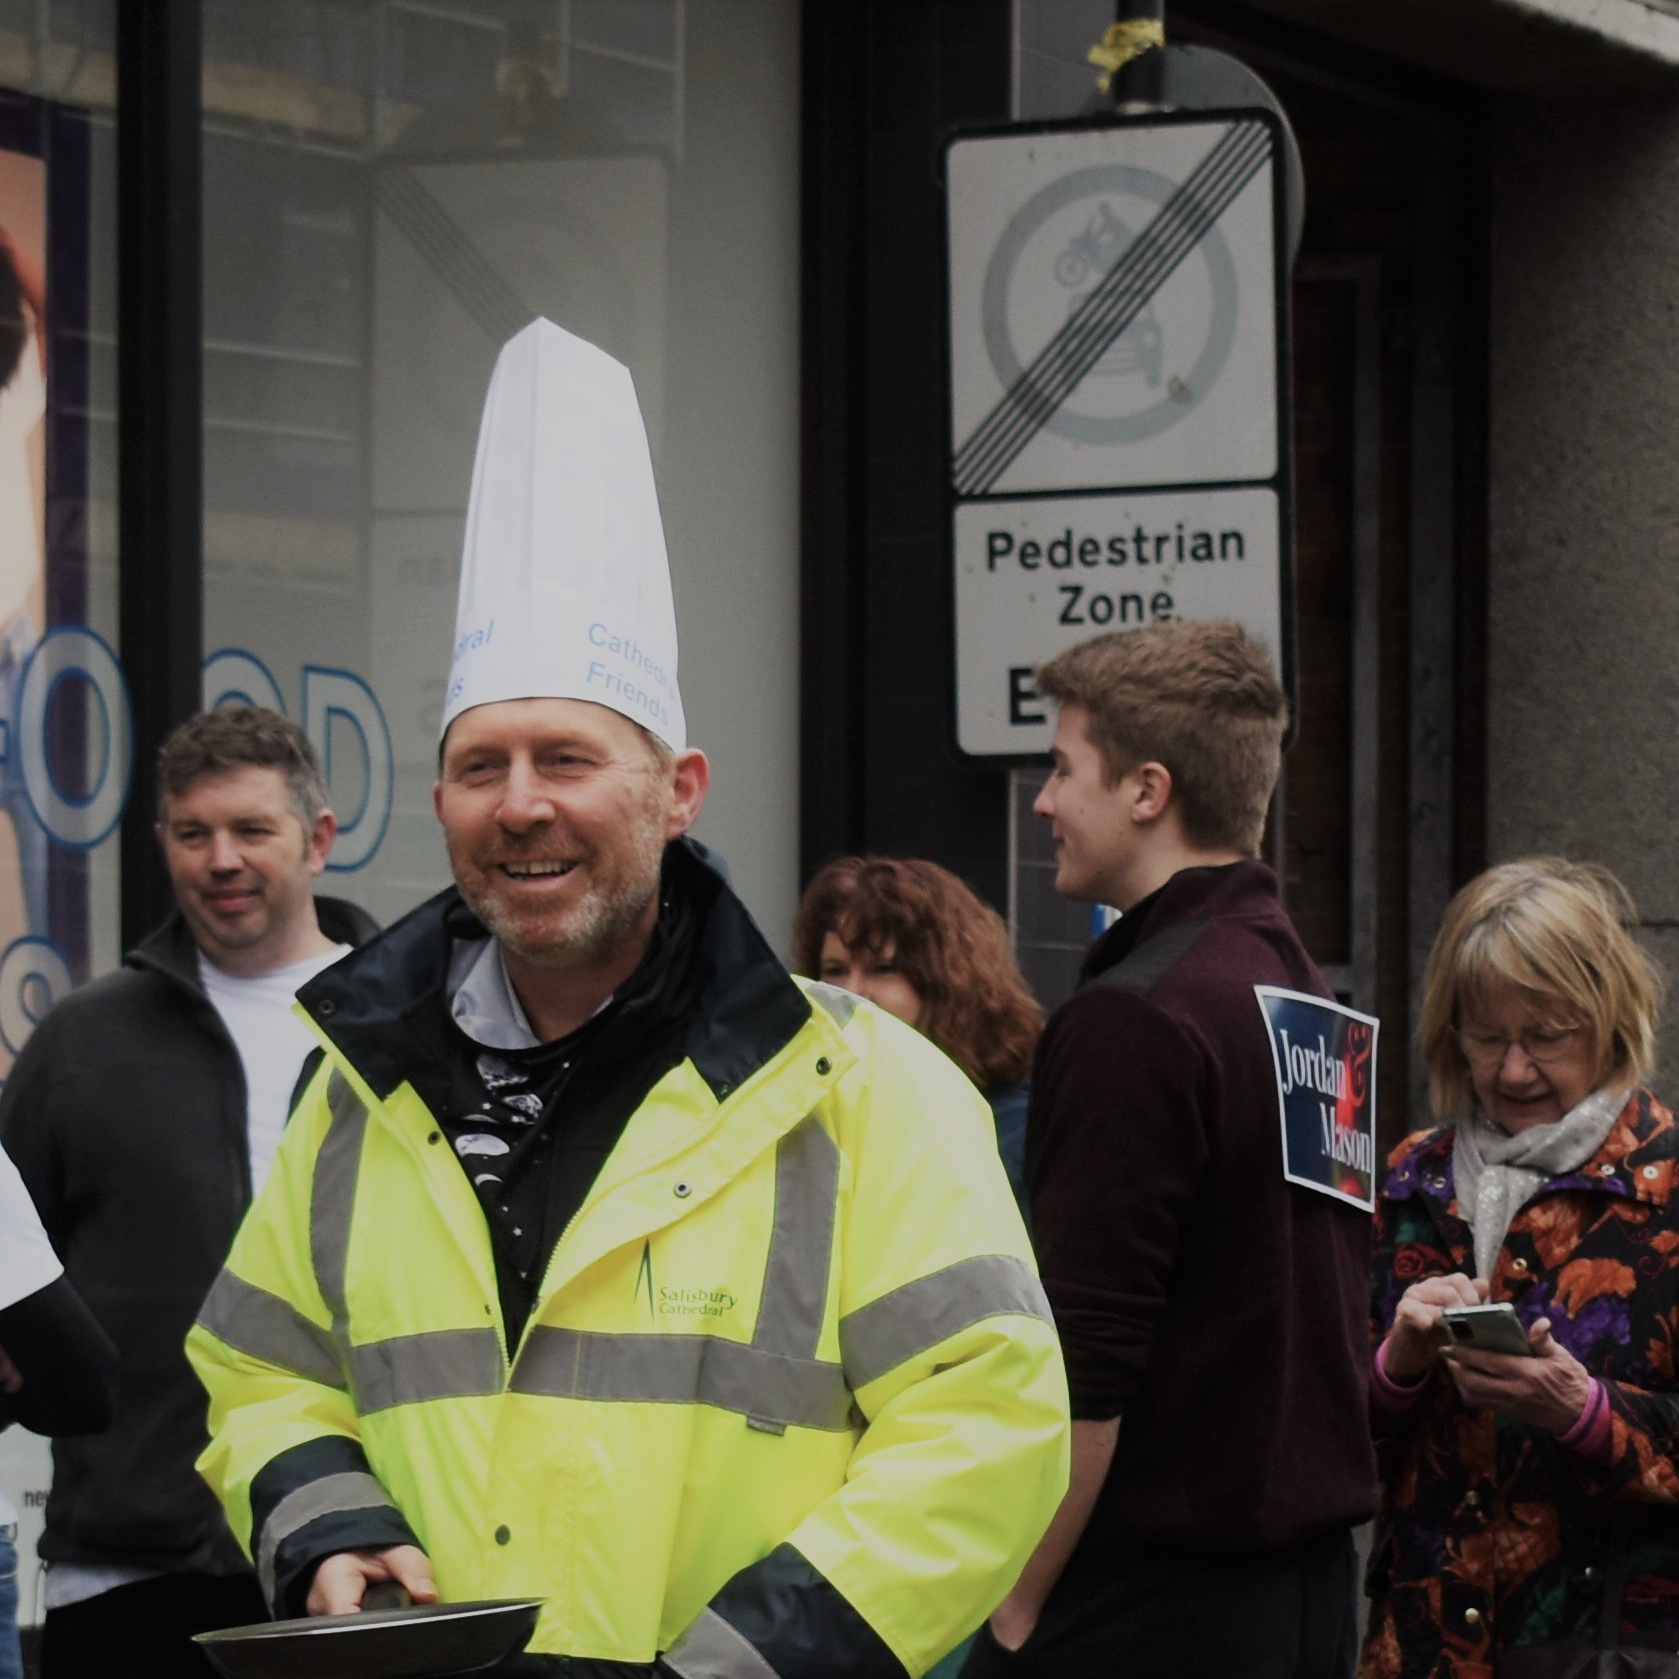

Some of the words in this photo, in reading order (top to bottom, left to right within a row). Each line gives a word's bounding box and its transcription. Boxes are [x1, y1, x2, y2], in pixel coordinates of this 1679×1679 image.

[986, 523, 1246, 572] Pedestrian
[1058, 585, 1175, 625] Zone
[1280, 1028, 1347, 1102] Jordan
[1347, 1020, 1372, 1108] &
[1319, 1101, 1372, 1174] Mason
[658, 1286, 739, 1311] Salisbury
[658, 1302, 724, 1317] Cathedral
